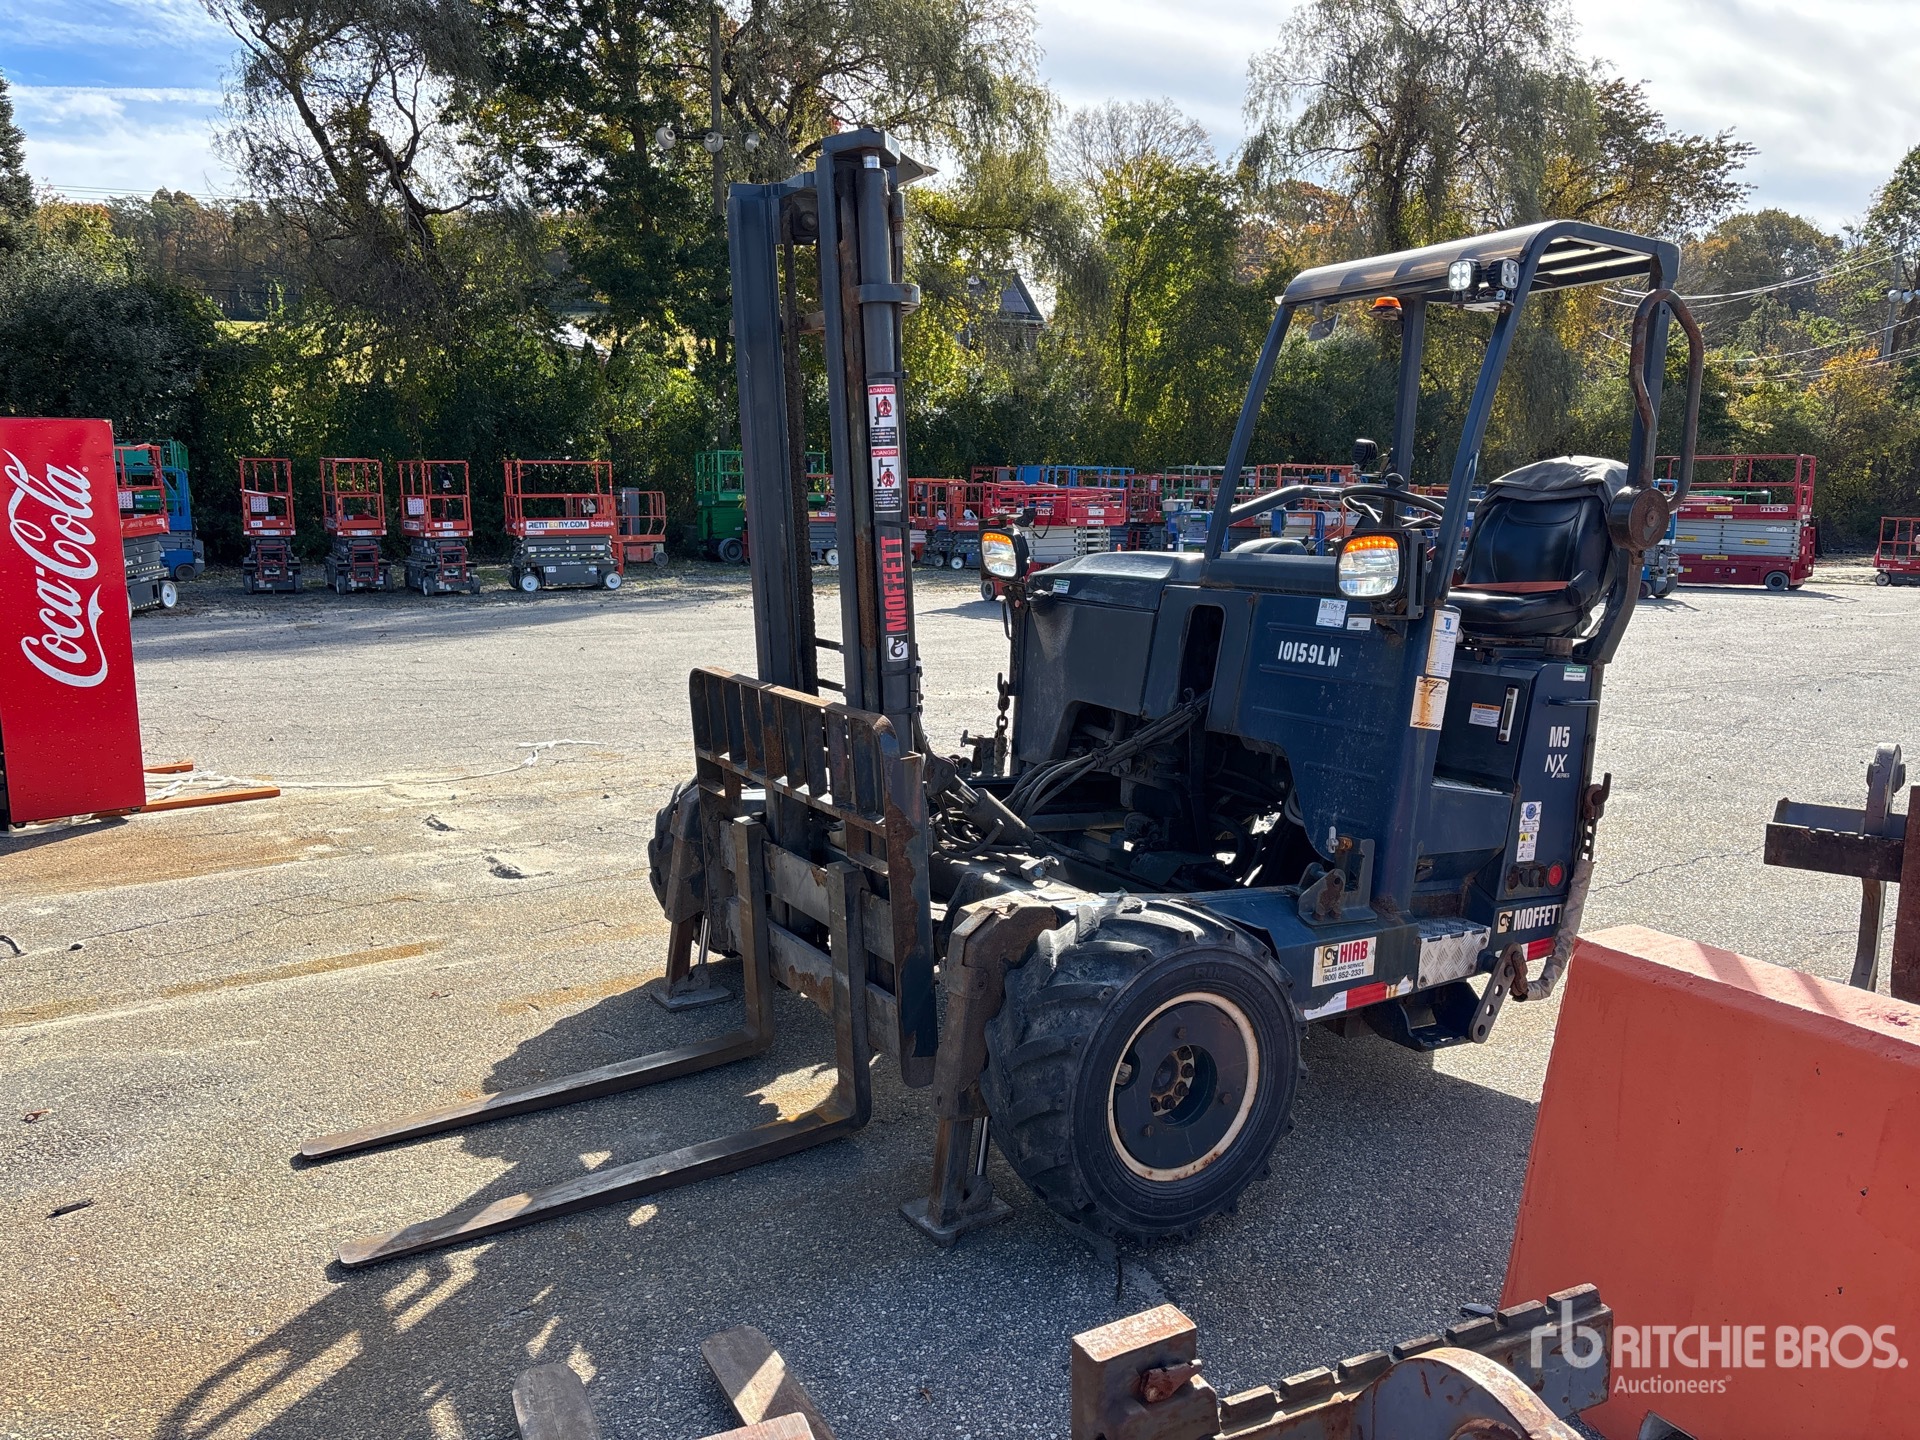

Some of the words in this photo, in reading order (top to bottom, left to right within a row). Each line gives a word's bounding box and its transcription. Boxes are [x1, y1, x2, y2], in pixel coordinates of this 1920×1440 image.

[2, 448, 108, 687] Coca-Cola
[881, 536, 908, 632] MOFFETT
[1548, 726, 1571, 748] M5
[1544, 754, 1568, 778] NX
[1339, 940, 1369, 964] HIAB
[1347, 961, 1365, 969] SERVICE
[1322, 973, 1337, 983] (800)
